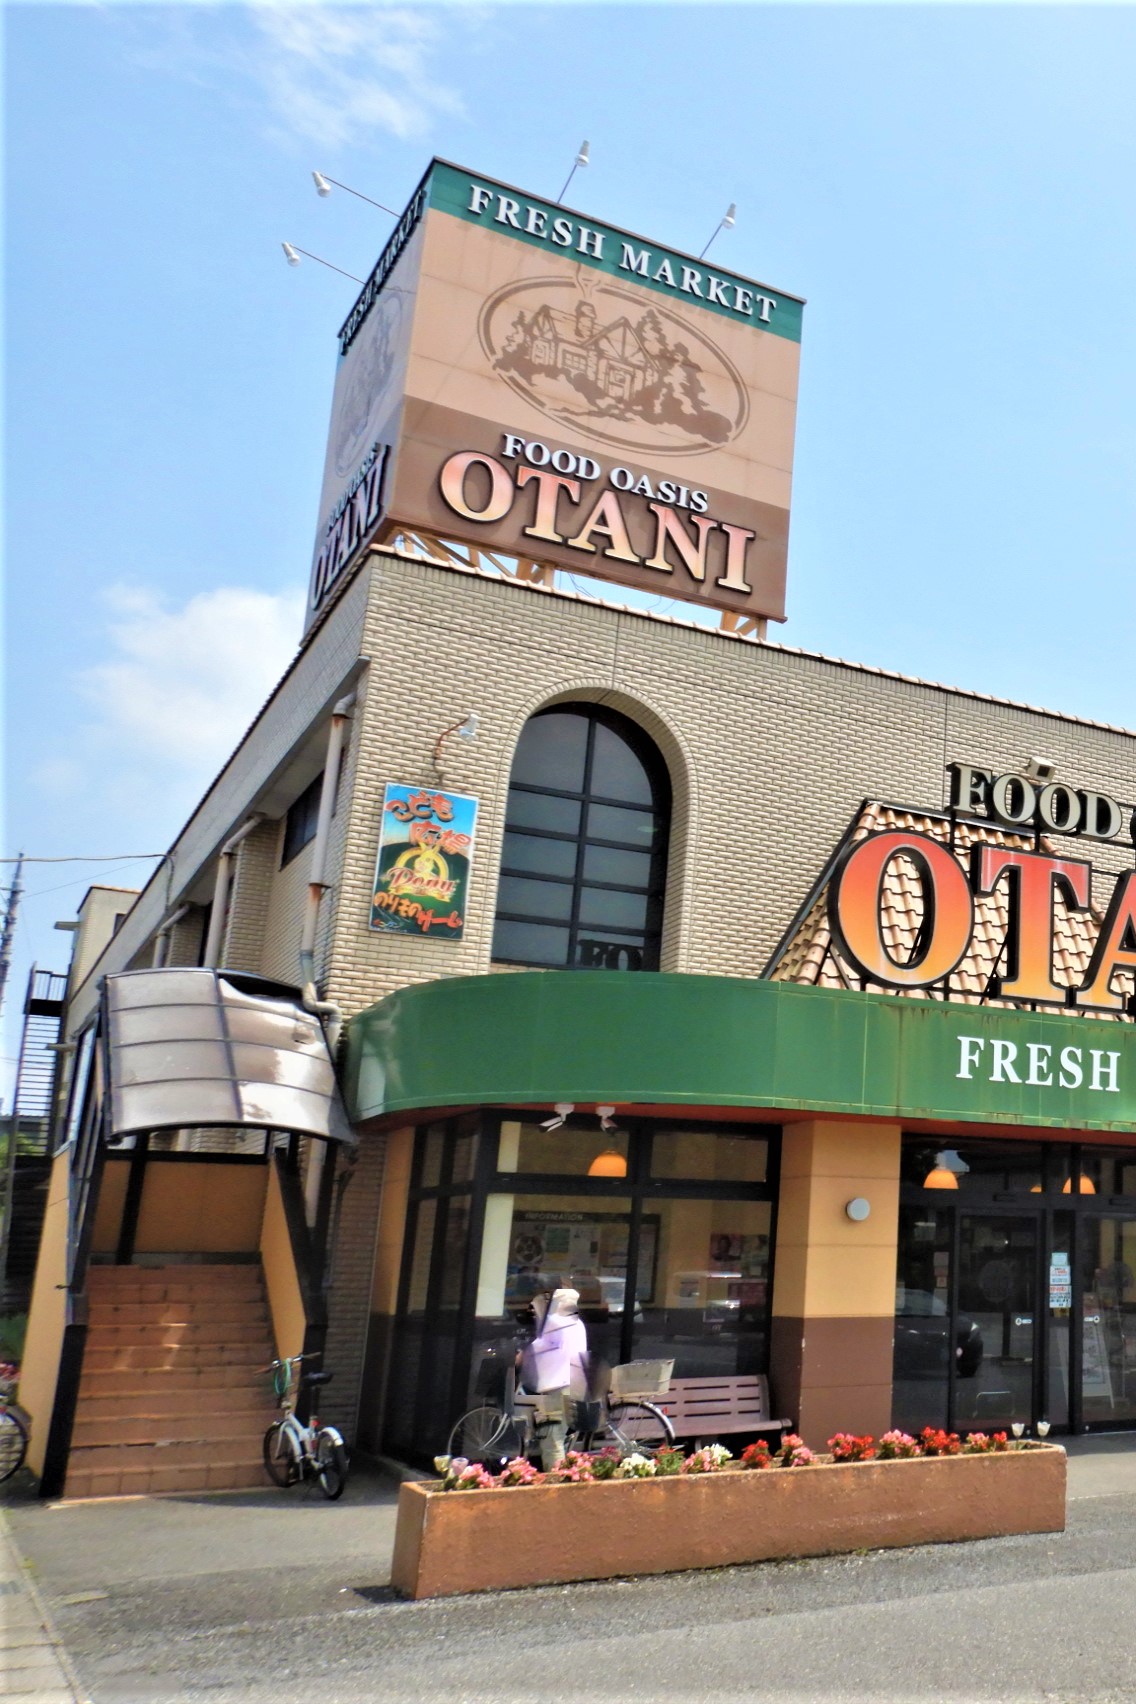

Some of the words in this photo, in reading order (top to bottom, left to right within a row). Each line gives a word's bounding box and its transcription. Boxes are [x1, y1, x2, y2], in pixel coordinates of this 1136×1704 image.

[469, 184, 605, 261] FRESH
[621, 242, 777, 323] MARKET
[502, 432, 601, 481] FOOD
[609, 467, 709, 513] OASIS
[311, 444, 391, 611] OTANI
[438, 449, 756, 594] OTANI
[384, 791, 454, 822] こども
[410, 820, 472, 855] 広場
[946, 761, 1123, 840] FOOD
[955, 1035, 1121, 1093] FRESH
